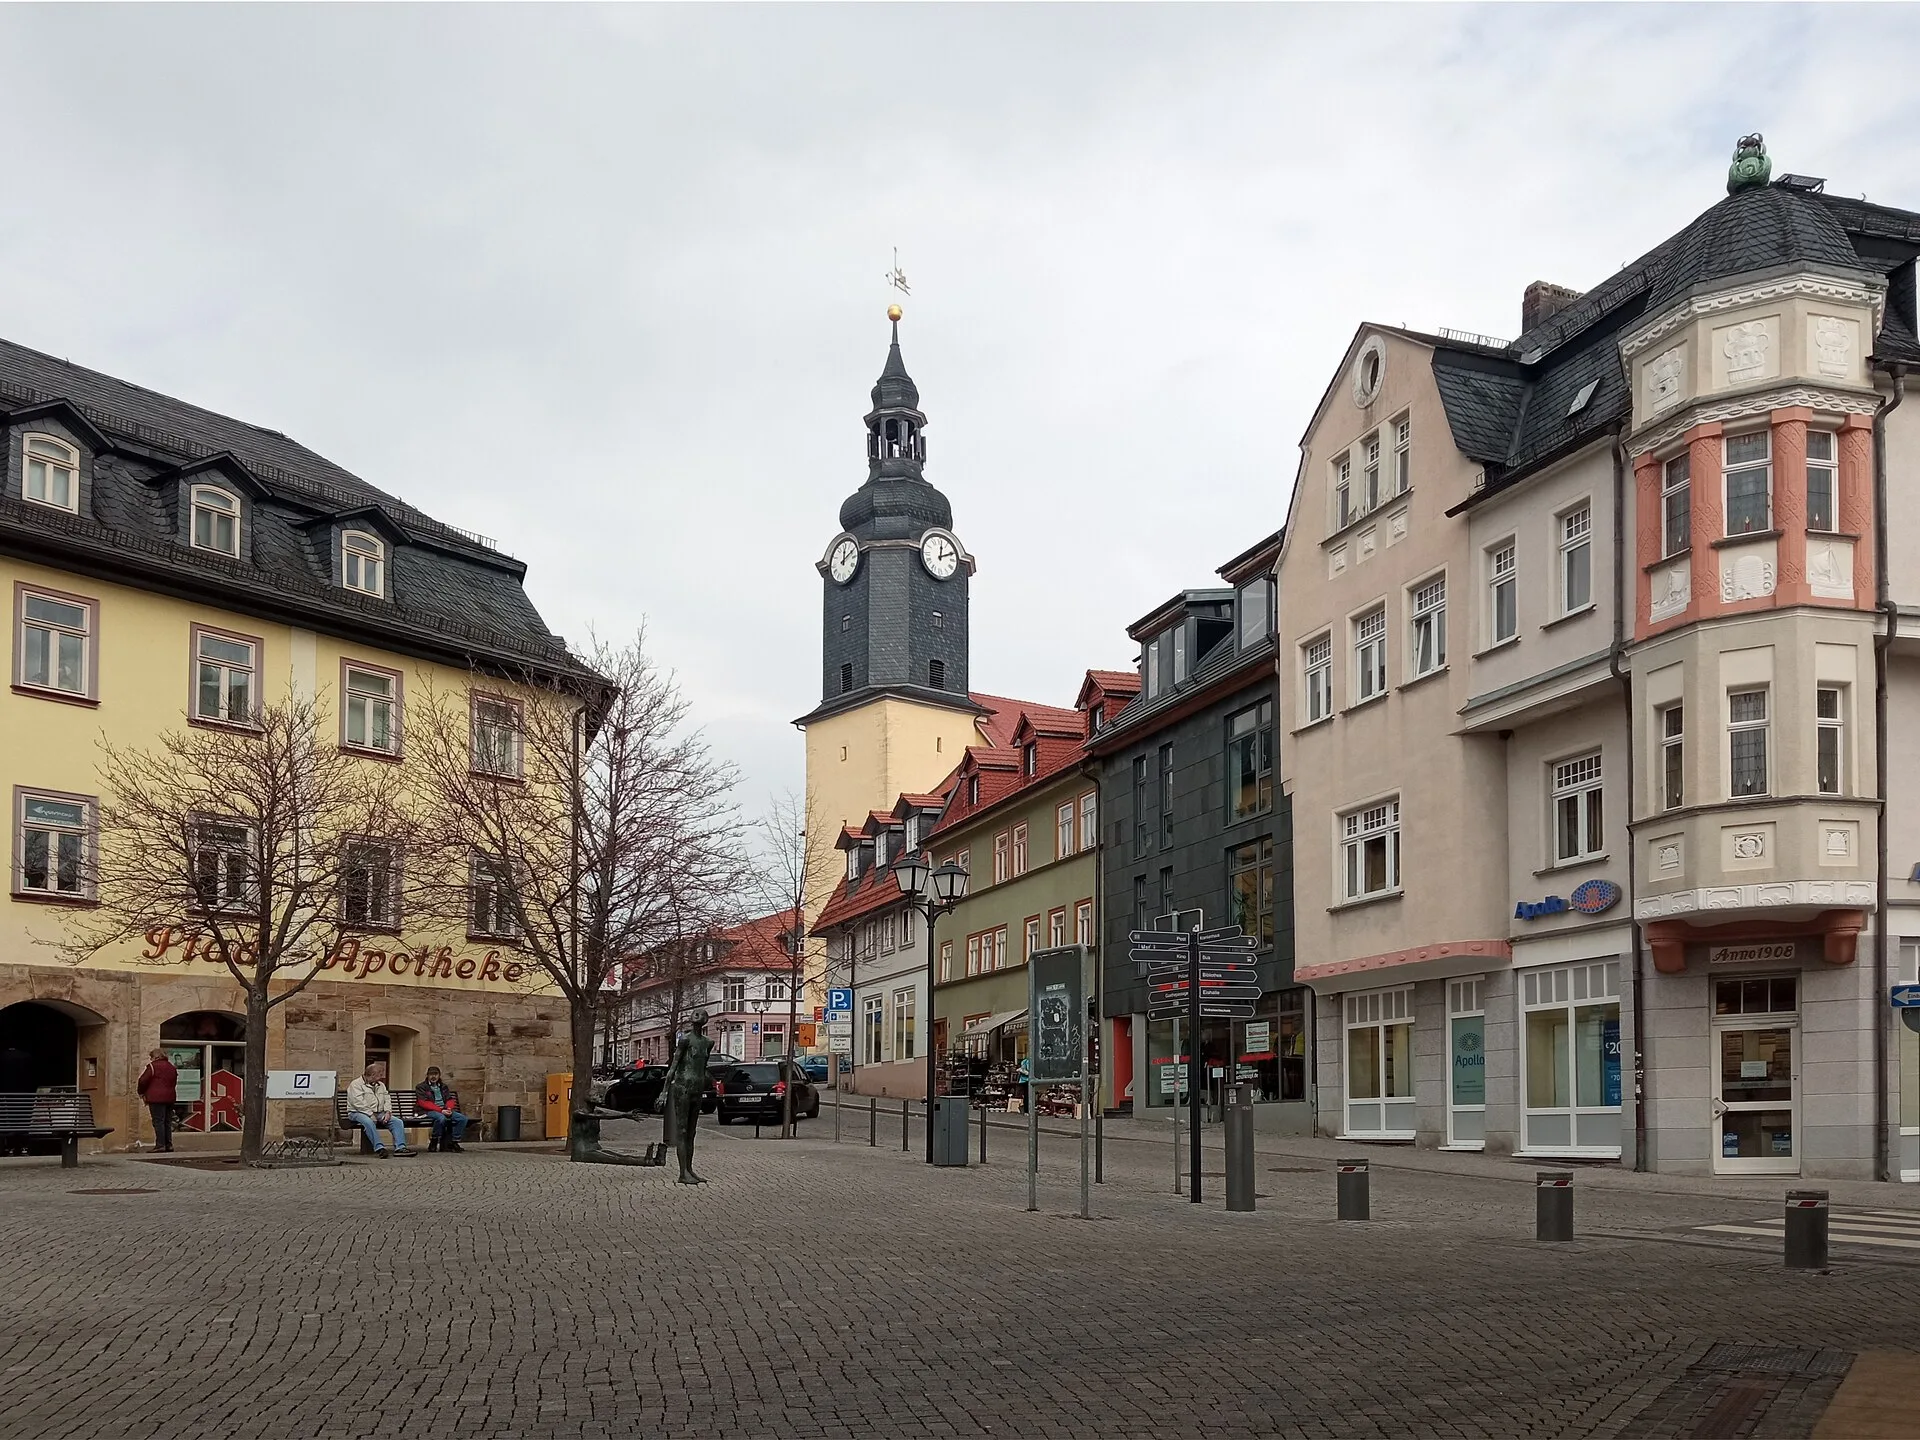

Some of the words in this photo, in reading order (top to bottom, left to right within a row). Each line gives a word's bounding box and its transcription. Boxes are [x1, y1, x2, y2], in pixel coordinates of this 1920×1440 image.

[315, 938, 524, 983] Apotheke
[1712, 948, 1756, 962] Anno
[1757, 945, 1794, 959] 1908
[832, 991, 845, 1008] P
[1455, 1054, 1485, 1068] Apollo
